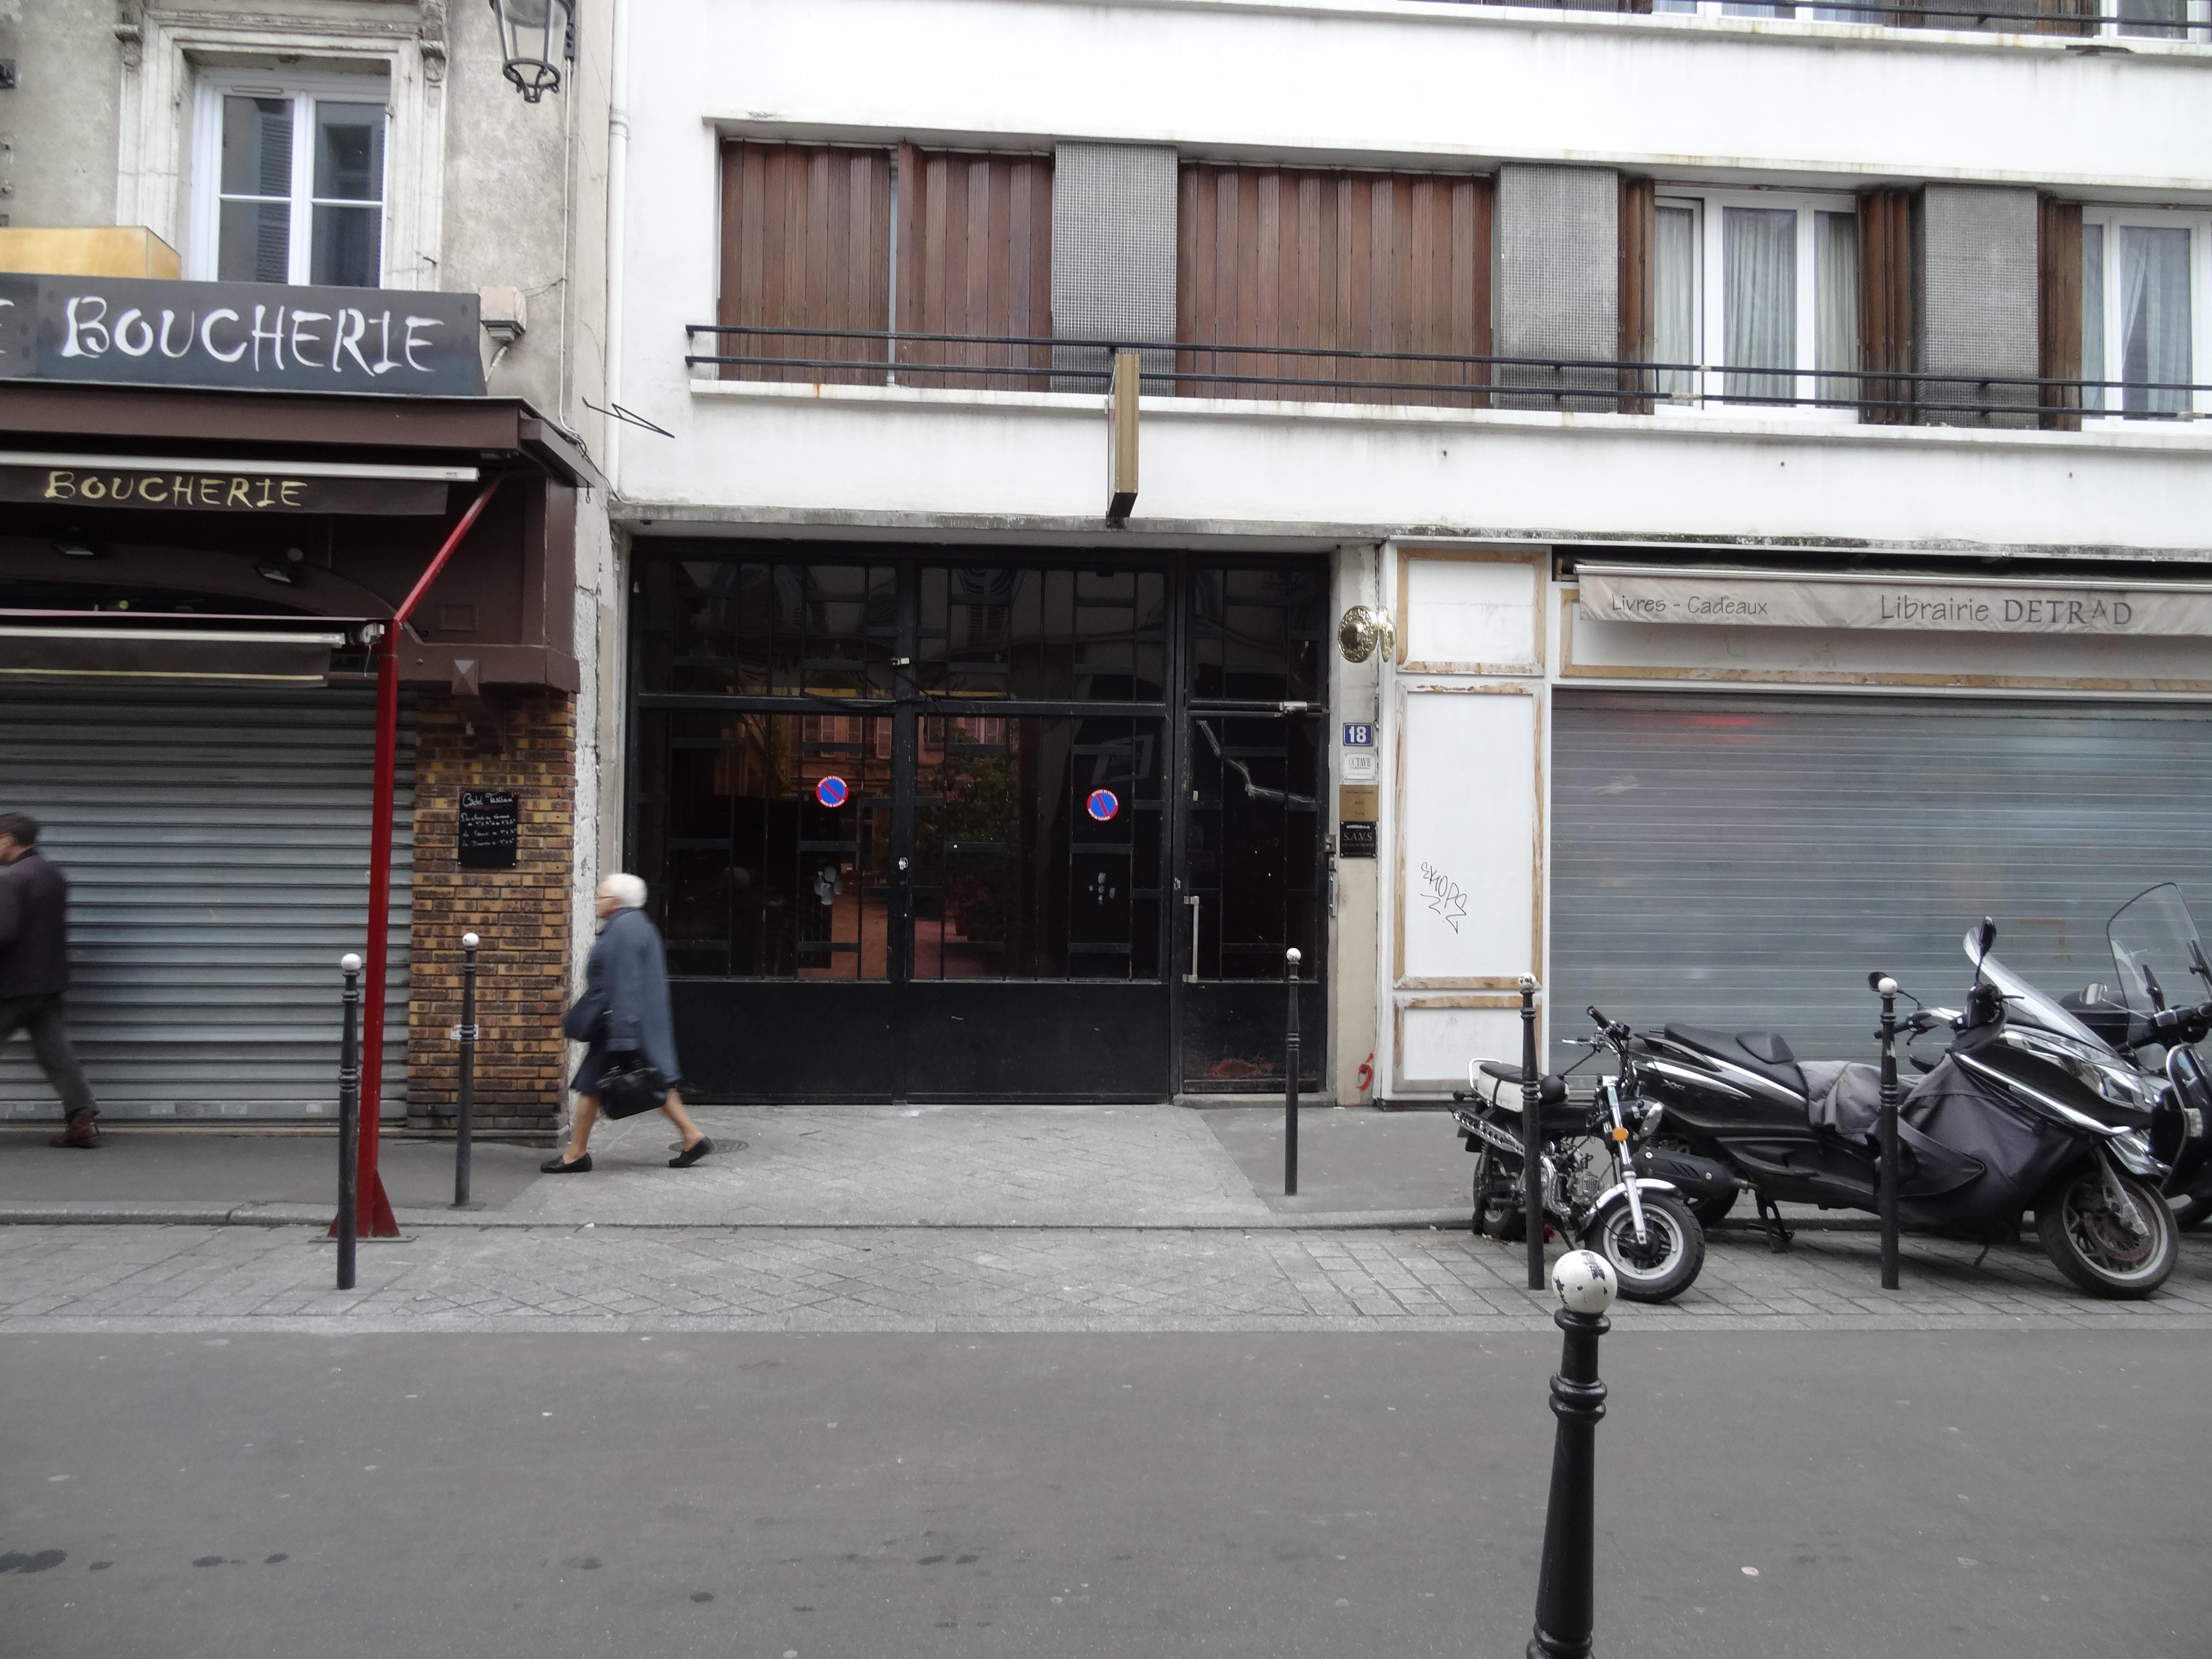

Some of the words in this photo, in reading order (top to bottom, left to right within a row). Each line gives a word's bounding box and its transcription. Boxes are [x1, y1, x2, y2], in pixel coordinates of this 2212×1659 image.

[61, 296, 444, 376] BOUCHERIE
[44, 471, 307, 509] BOUCHERIE
[1612, 593, 1666, 612] Livres
[1687, 596, 1768, 615] Cadeaux
[1881, 594, 1989, 622] Librairie
[2003, 599, 2132, 625] DETRAD
[1349, 726, 1366, 743] 18
[1349, 758, 1371, 767] OCTAVE
